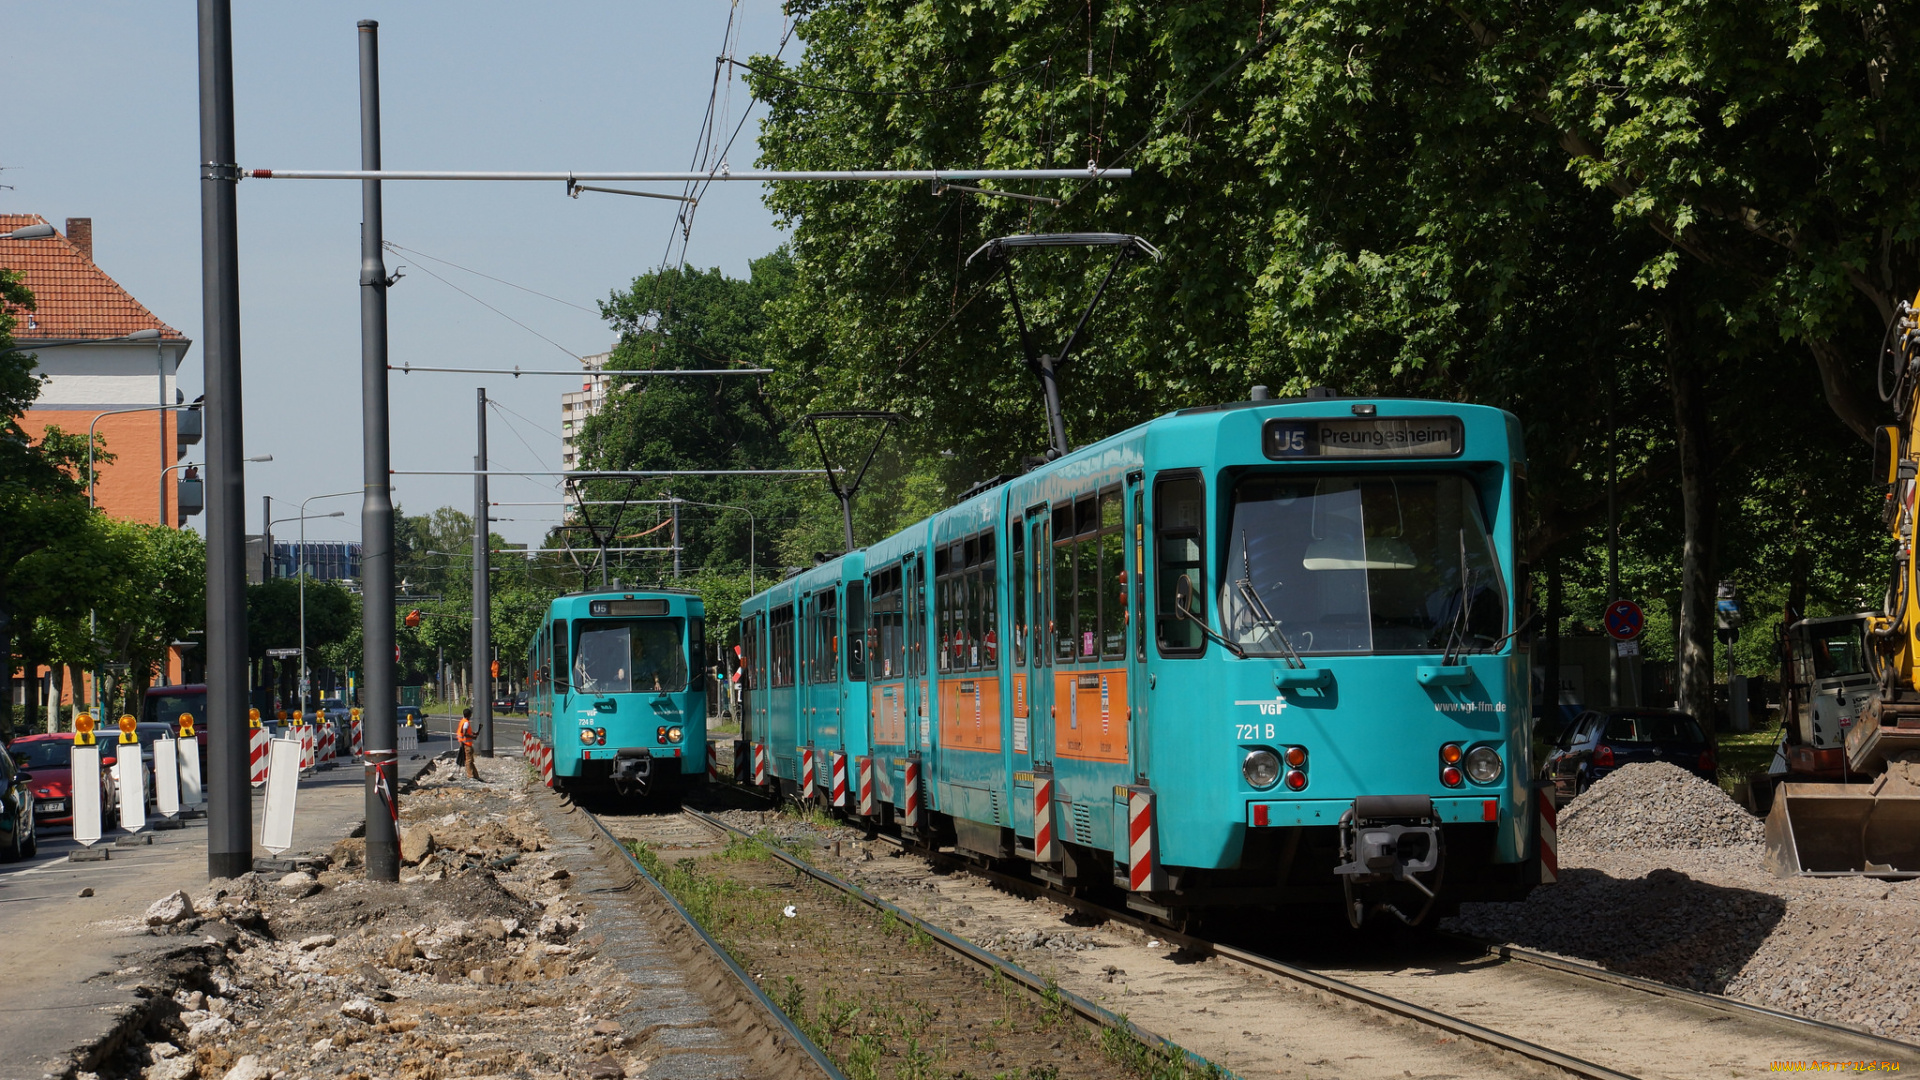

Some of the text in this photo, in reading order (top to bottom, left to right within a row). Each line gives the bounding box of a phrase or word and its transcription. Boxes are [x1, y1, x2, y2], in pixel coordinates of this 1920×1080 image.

[1274, 427, 1448, 451] U5 Preungesheim
[1260, 703, 1287, 715] VGF
[1434, 702, 1508, 714] www.vgf-ffm.de
[1235, 723, 1275, 740] 721 B
